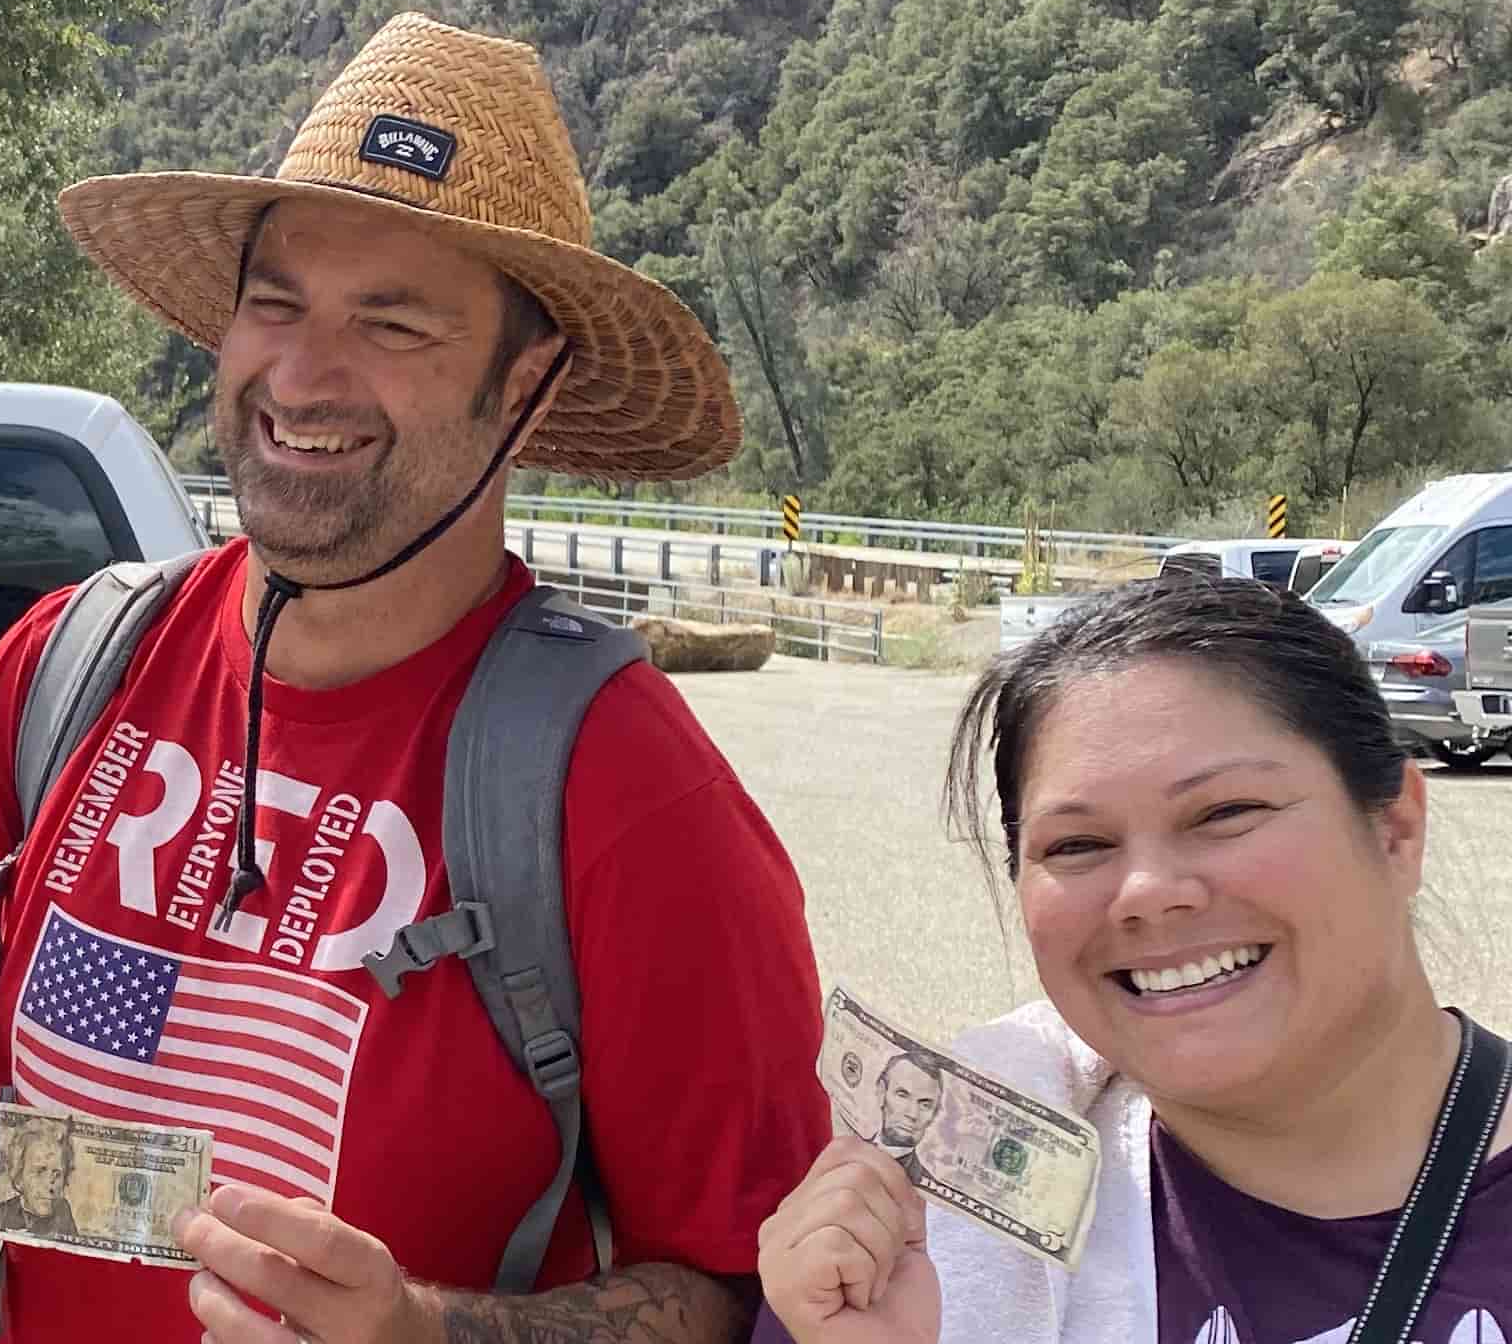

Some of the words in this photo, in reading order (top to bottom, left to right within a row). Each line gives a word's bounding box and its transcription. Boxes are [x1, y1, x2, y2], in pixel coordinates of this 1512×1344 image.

[44, 720, 150, 894] REMEMBER
[165, 759, 247, 932] EVERYONE
[268, 792, 362, 966] DEPLOYED
[918, 1175, 1029, 1236] DOLLARS
[1040, 1229, 1065, 1253] 5
